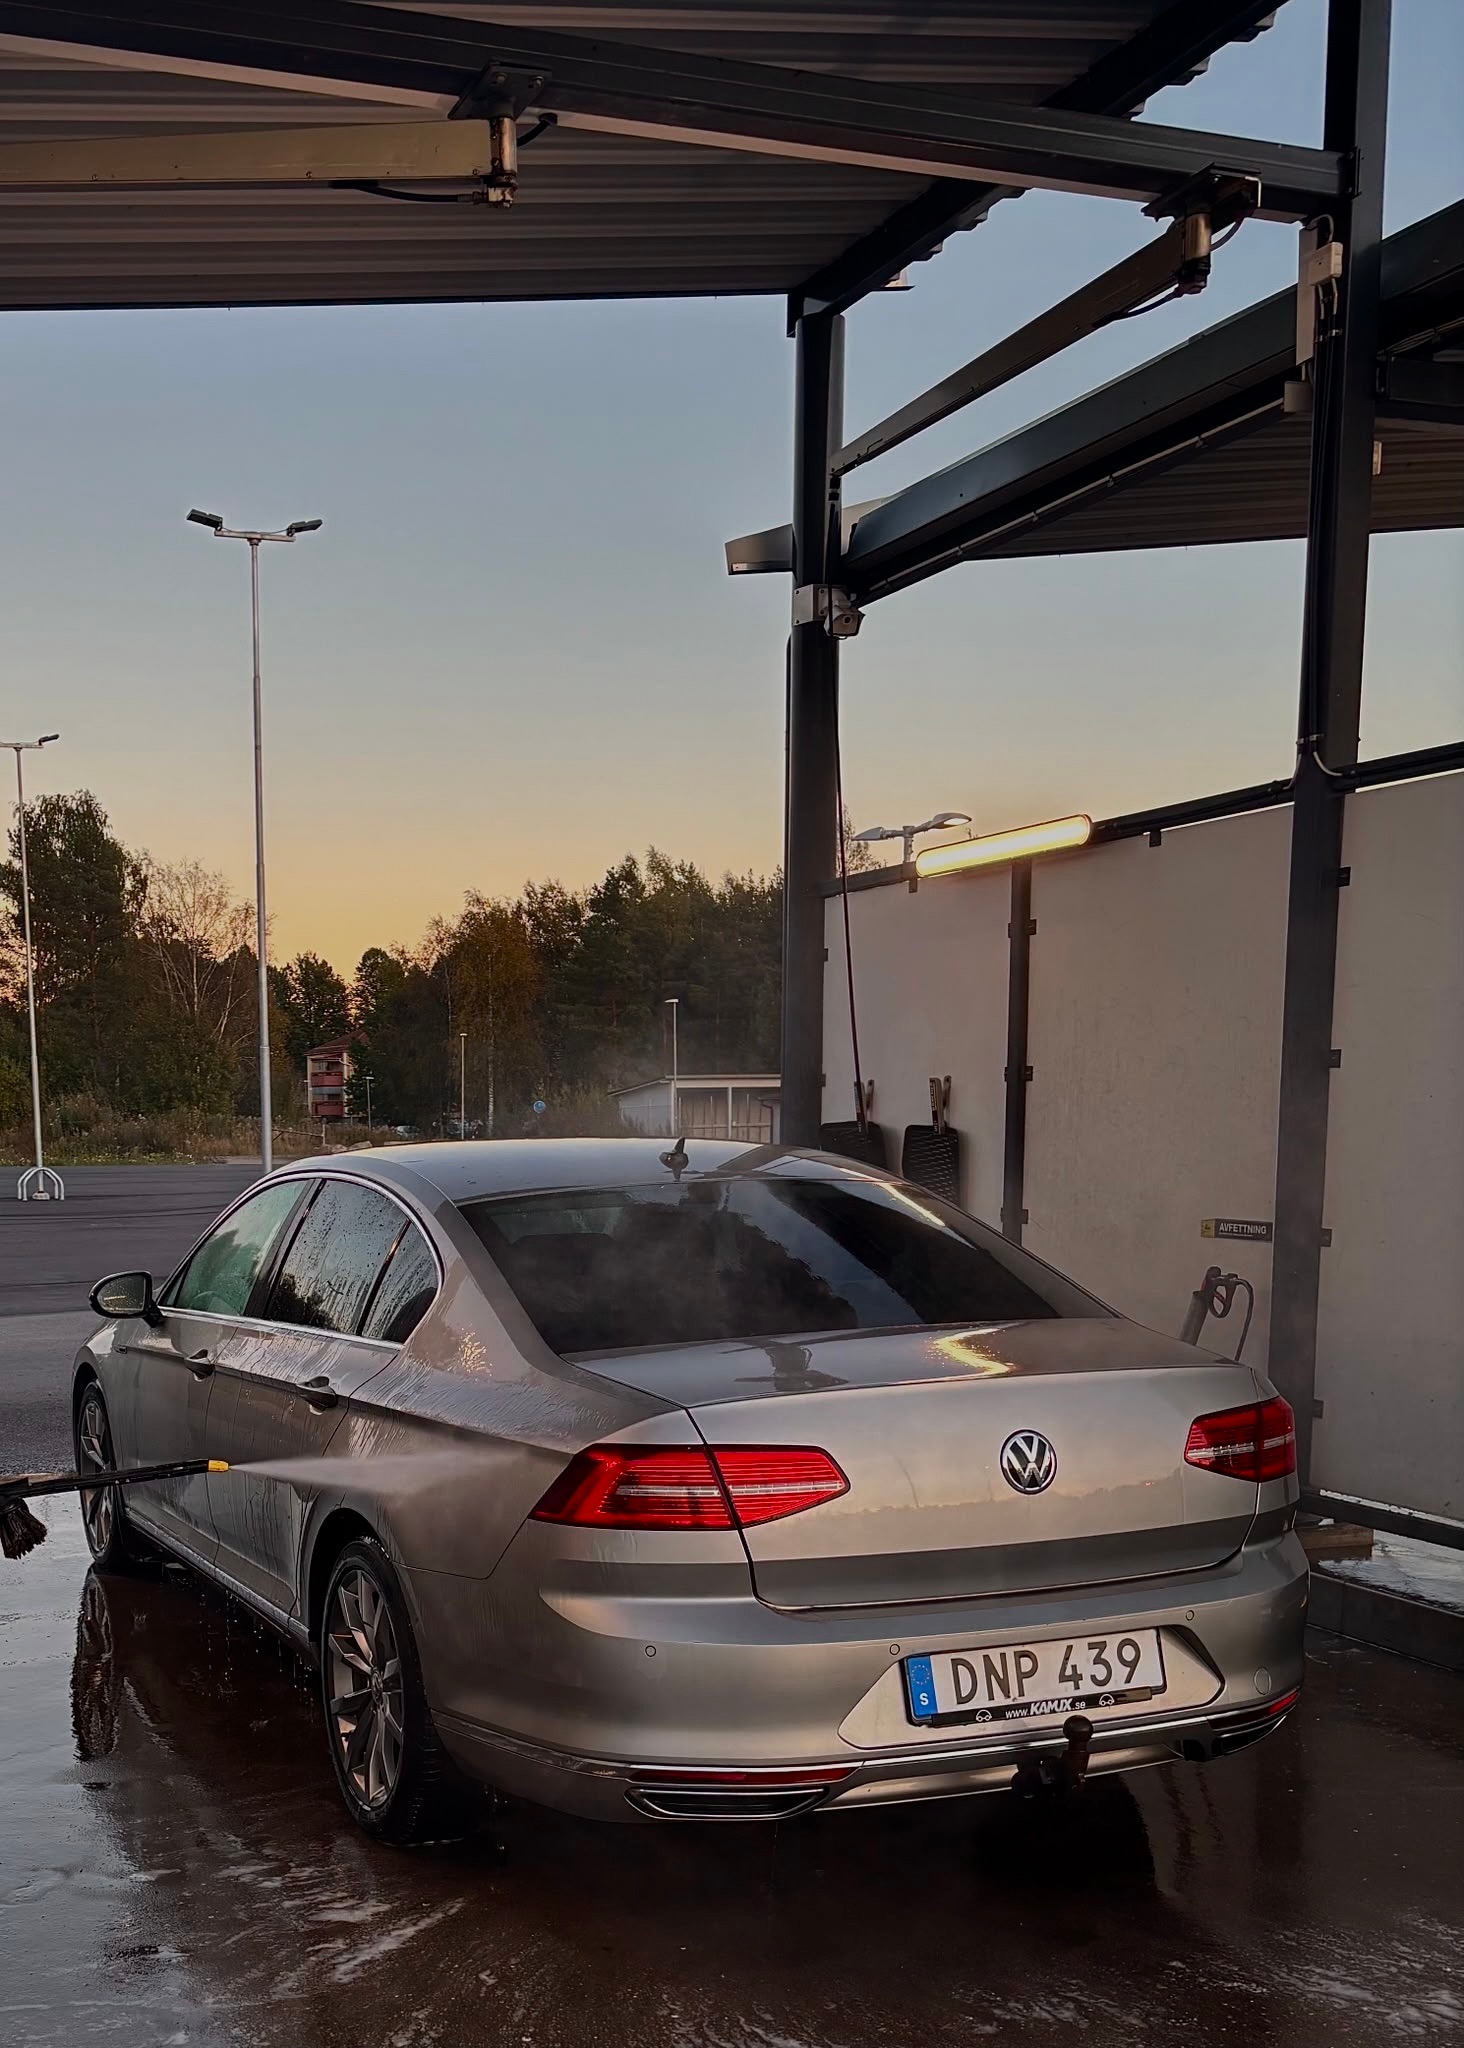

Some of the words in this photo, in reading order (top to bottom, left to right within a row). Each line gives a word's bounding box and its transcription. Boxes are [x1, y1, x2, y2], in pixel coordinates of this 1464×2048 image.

[1219, 1222, 1267, 1235] AVFETTNING
[950, 1650, 1039, 1705] DNP
[1058, 1638, 1142, 1690] 439
[919, 1692, 929, 1706] S
